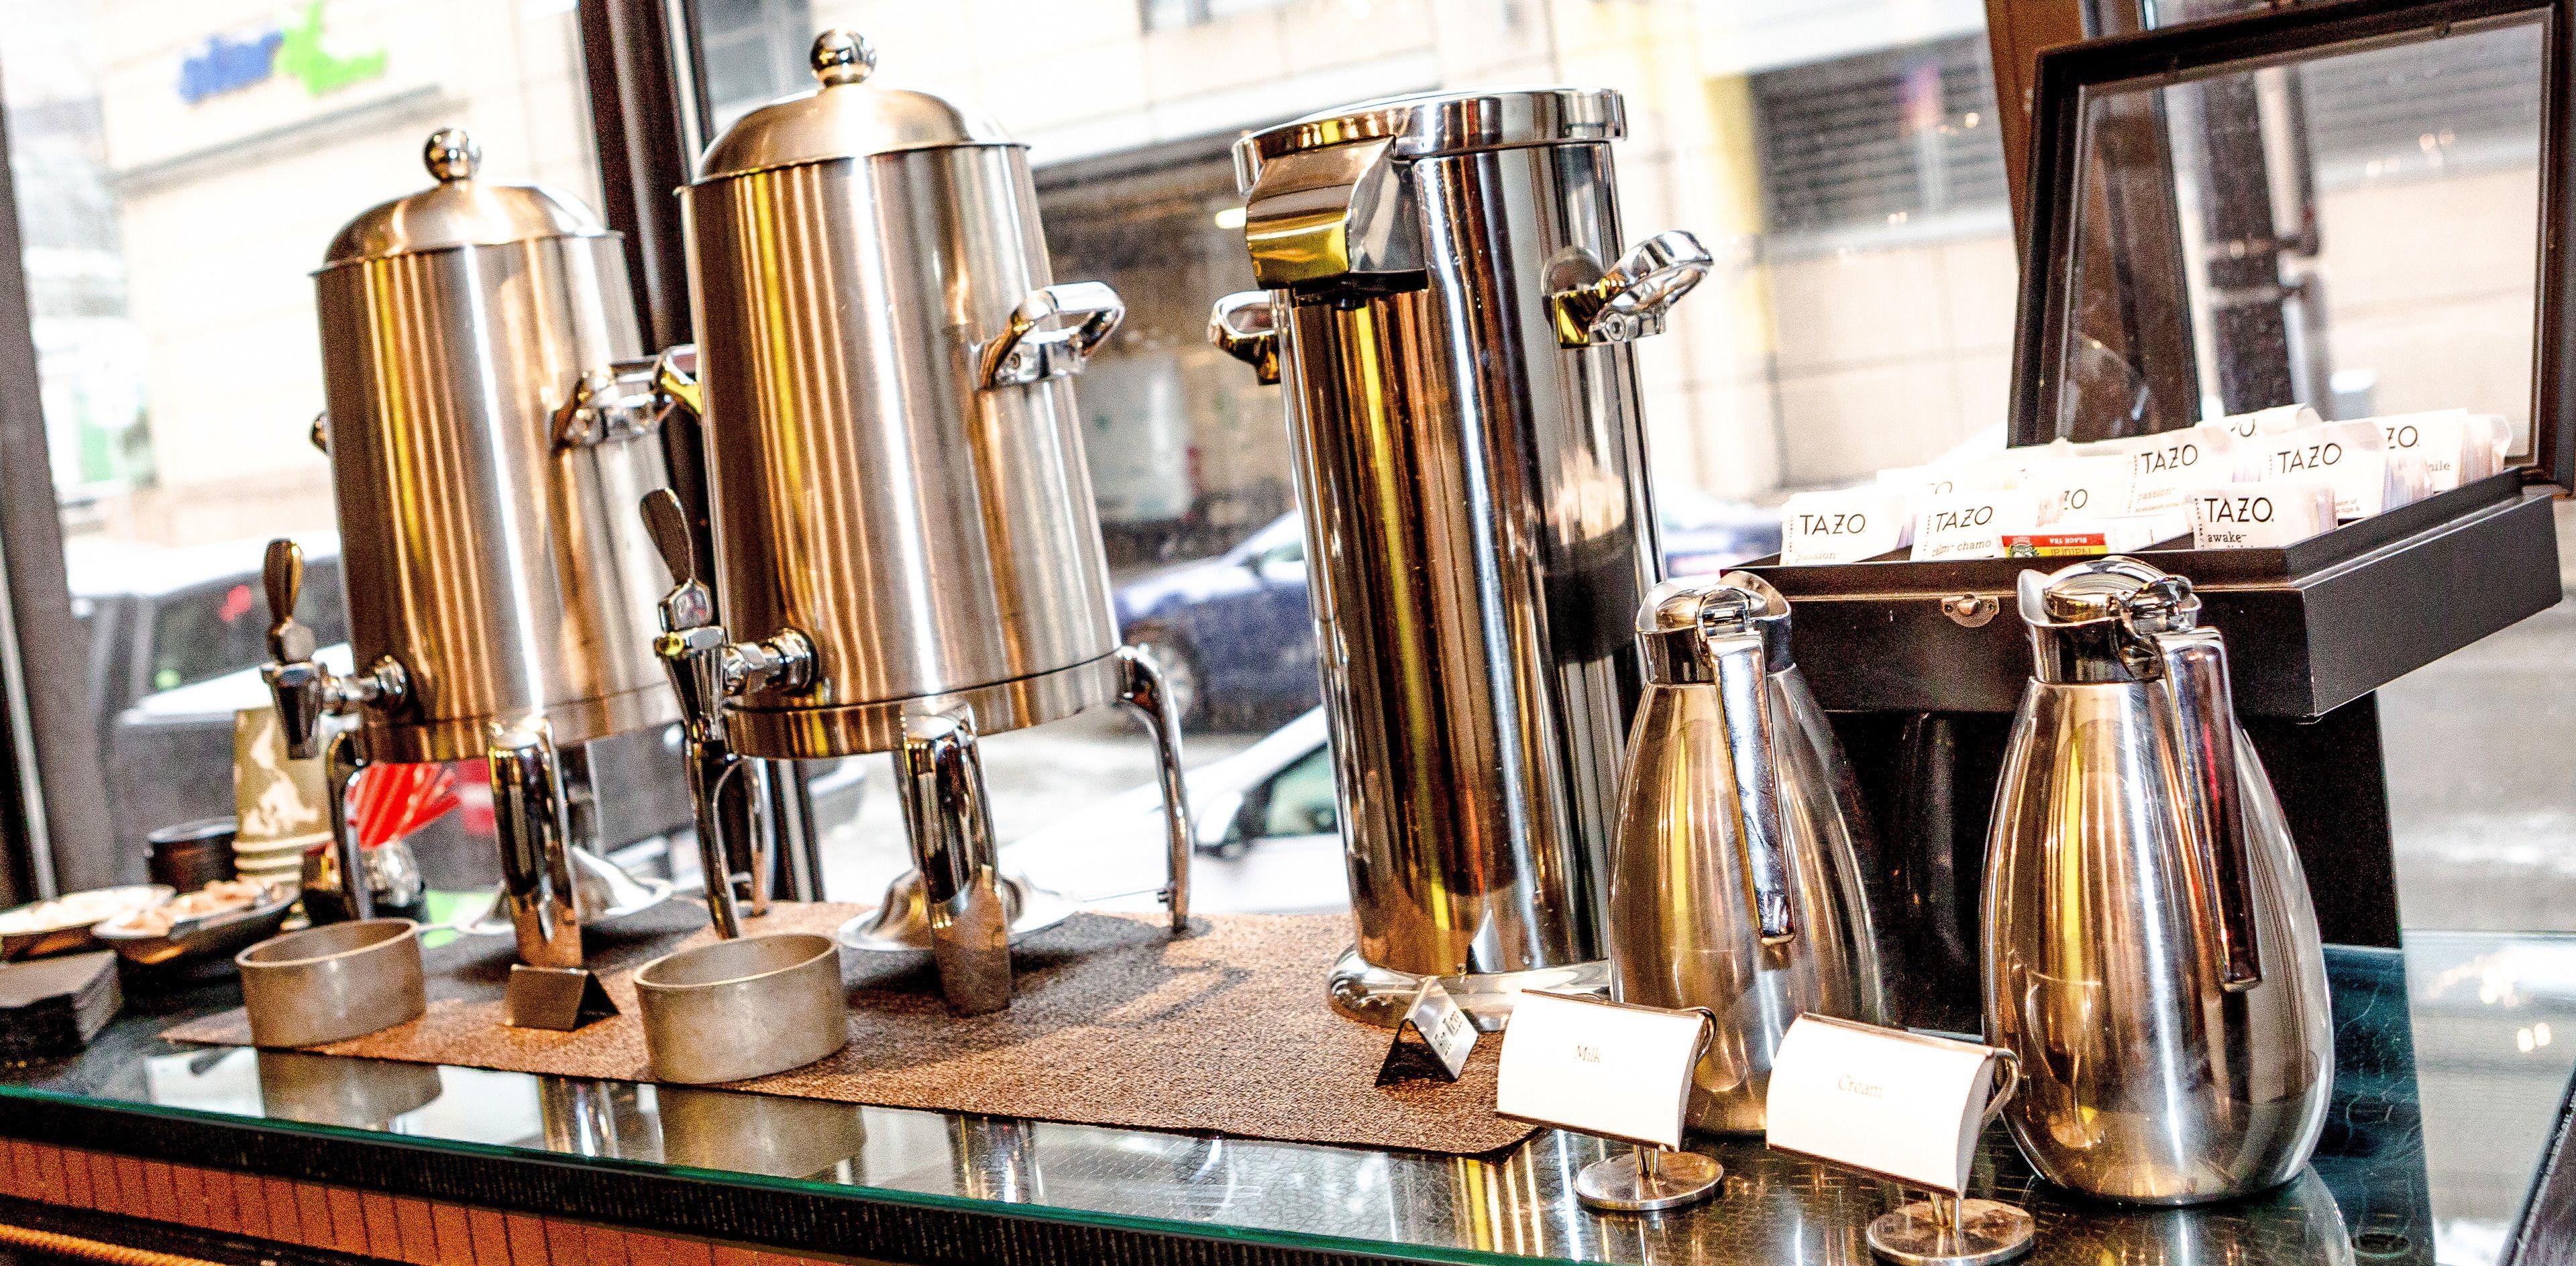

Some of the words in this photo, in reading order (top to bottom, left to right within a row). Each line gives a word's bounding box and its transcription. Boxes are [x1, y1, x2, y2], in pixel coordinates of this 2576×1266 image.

[2141, 443, 2198, 474] TAZO
[2277, 442, 2342, 474] TAZO
[1937, 506, 1992, 532] TAZO
[2204, 497, 2273, 522] TAZO
[1799, 514, 1866, 535] TAZO
